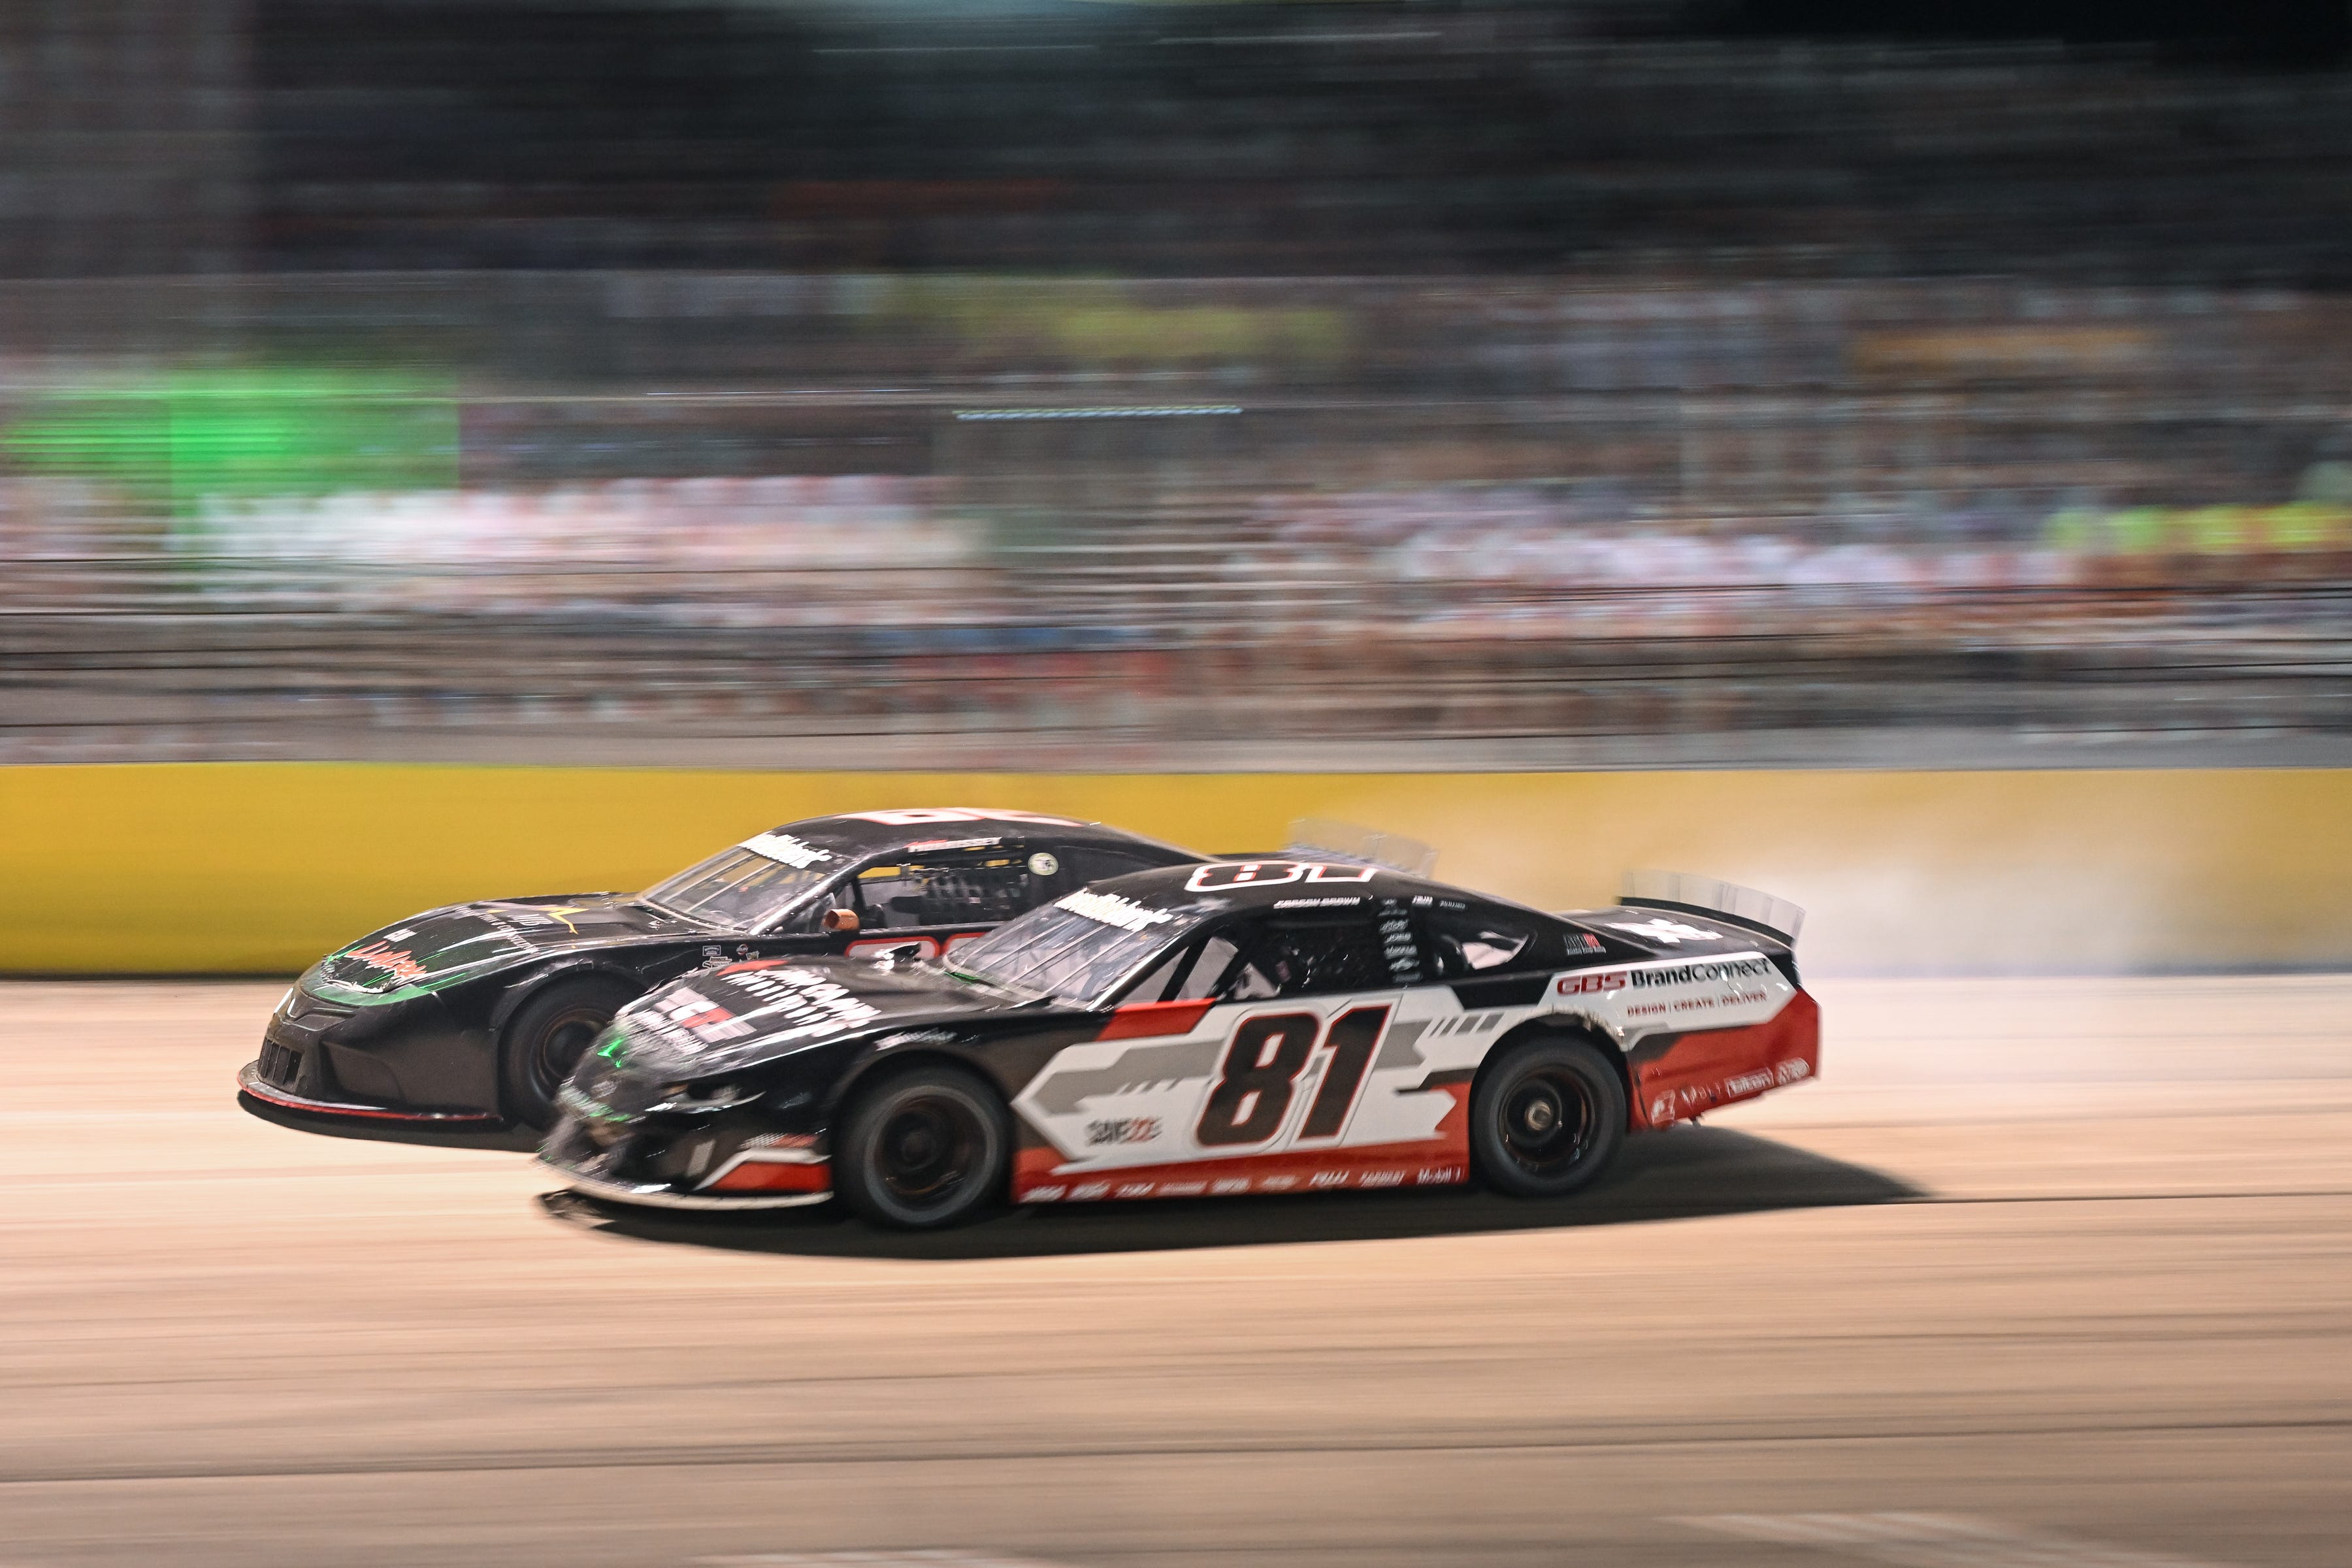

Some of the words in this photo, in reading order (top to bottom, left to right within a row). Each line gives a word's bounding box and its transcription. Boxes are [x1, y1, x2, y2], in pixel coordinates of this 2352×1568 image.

[1557, 971, 1628, 996] GBS
[1631, 958, 1772, 989] BrandConnect
[1627, 1004, 1666, 1018] DESIGN
[1674, 997, 1714, 1011] CREATE
[1722, 990, 1767, 1006] DELIVER
[1196, 1004, 1394, 1149] 81
